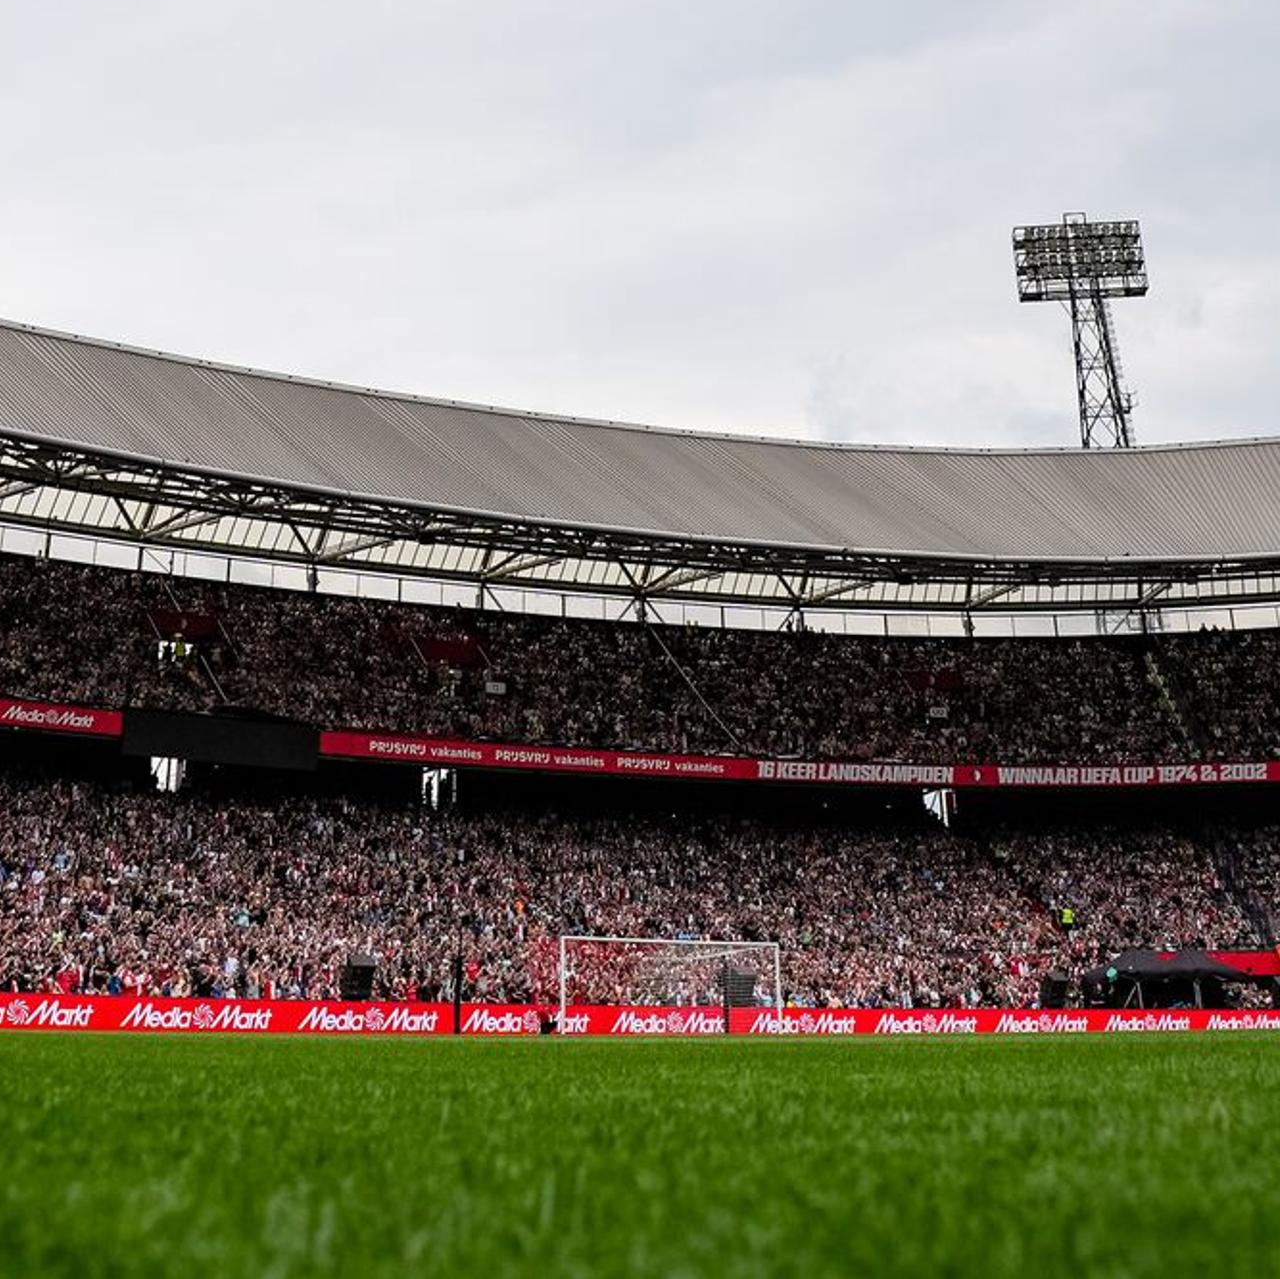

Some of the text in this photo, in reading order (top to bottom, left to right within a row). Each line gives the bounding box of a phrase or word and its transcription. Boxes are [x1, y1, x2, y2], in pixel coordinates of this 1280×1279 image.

[2, 706, 94, 727] Media Markt
[431, 746, 481, 760] vakanties
[554, 755, 604, 767] vakanties
[675, 761, 724, 773] vakanties
[758, 761, 953, 783] 16 KEER LANDSKAMPIOEN
[997, 763, 1267, 785] WINNAAR UEFA CUP 1974 & 2002
[23, 1000, 93, 1026] Markt
[121, 1003, 272, 1029] Media Markt
[298, 1007, 438, 1032] Media Markt
[462, 1009, 522, 1032] Media
[612, 1011, 674, 1033] Media
[813, 1013, 855, 1033] Markt
[875, 1014, 976, 1032] Media Markt
[995, 1014, 1038, 1032] Media
